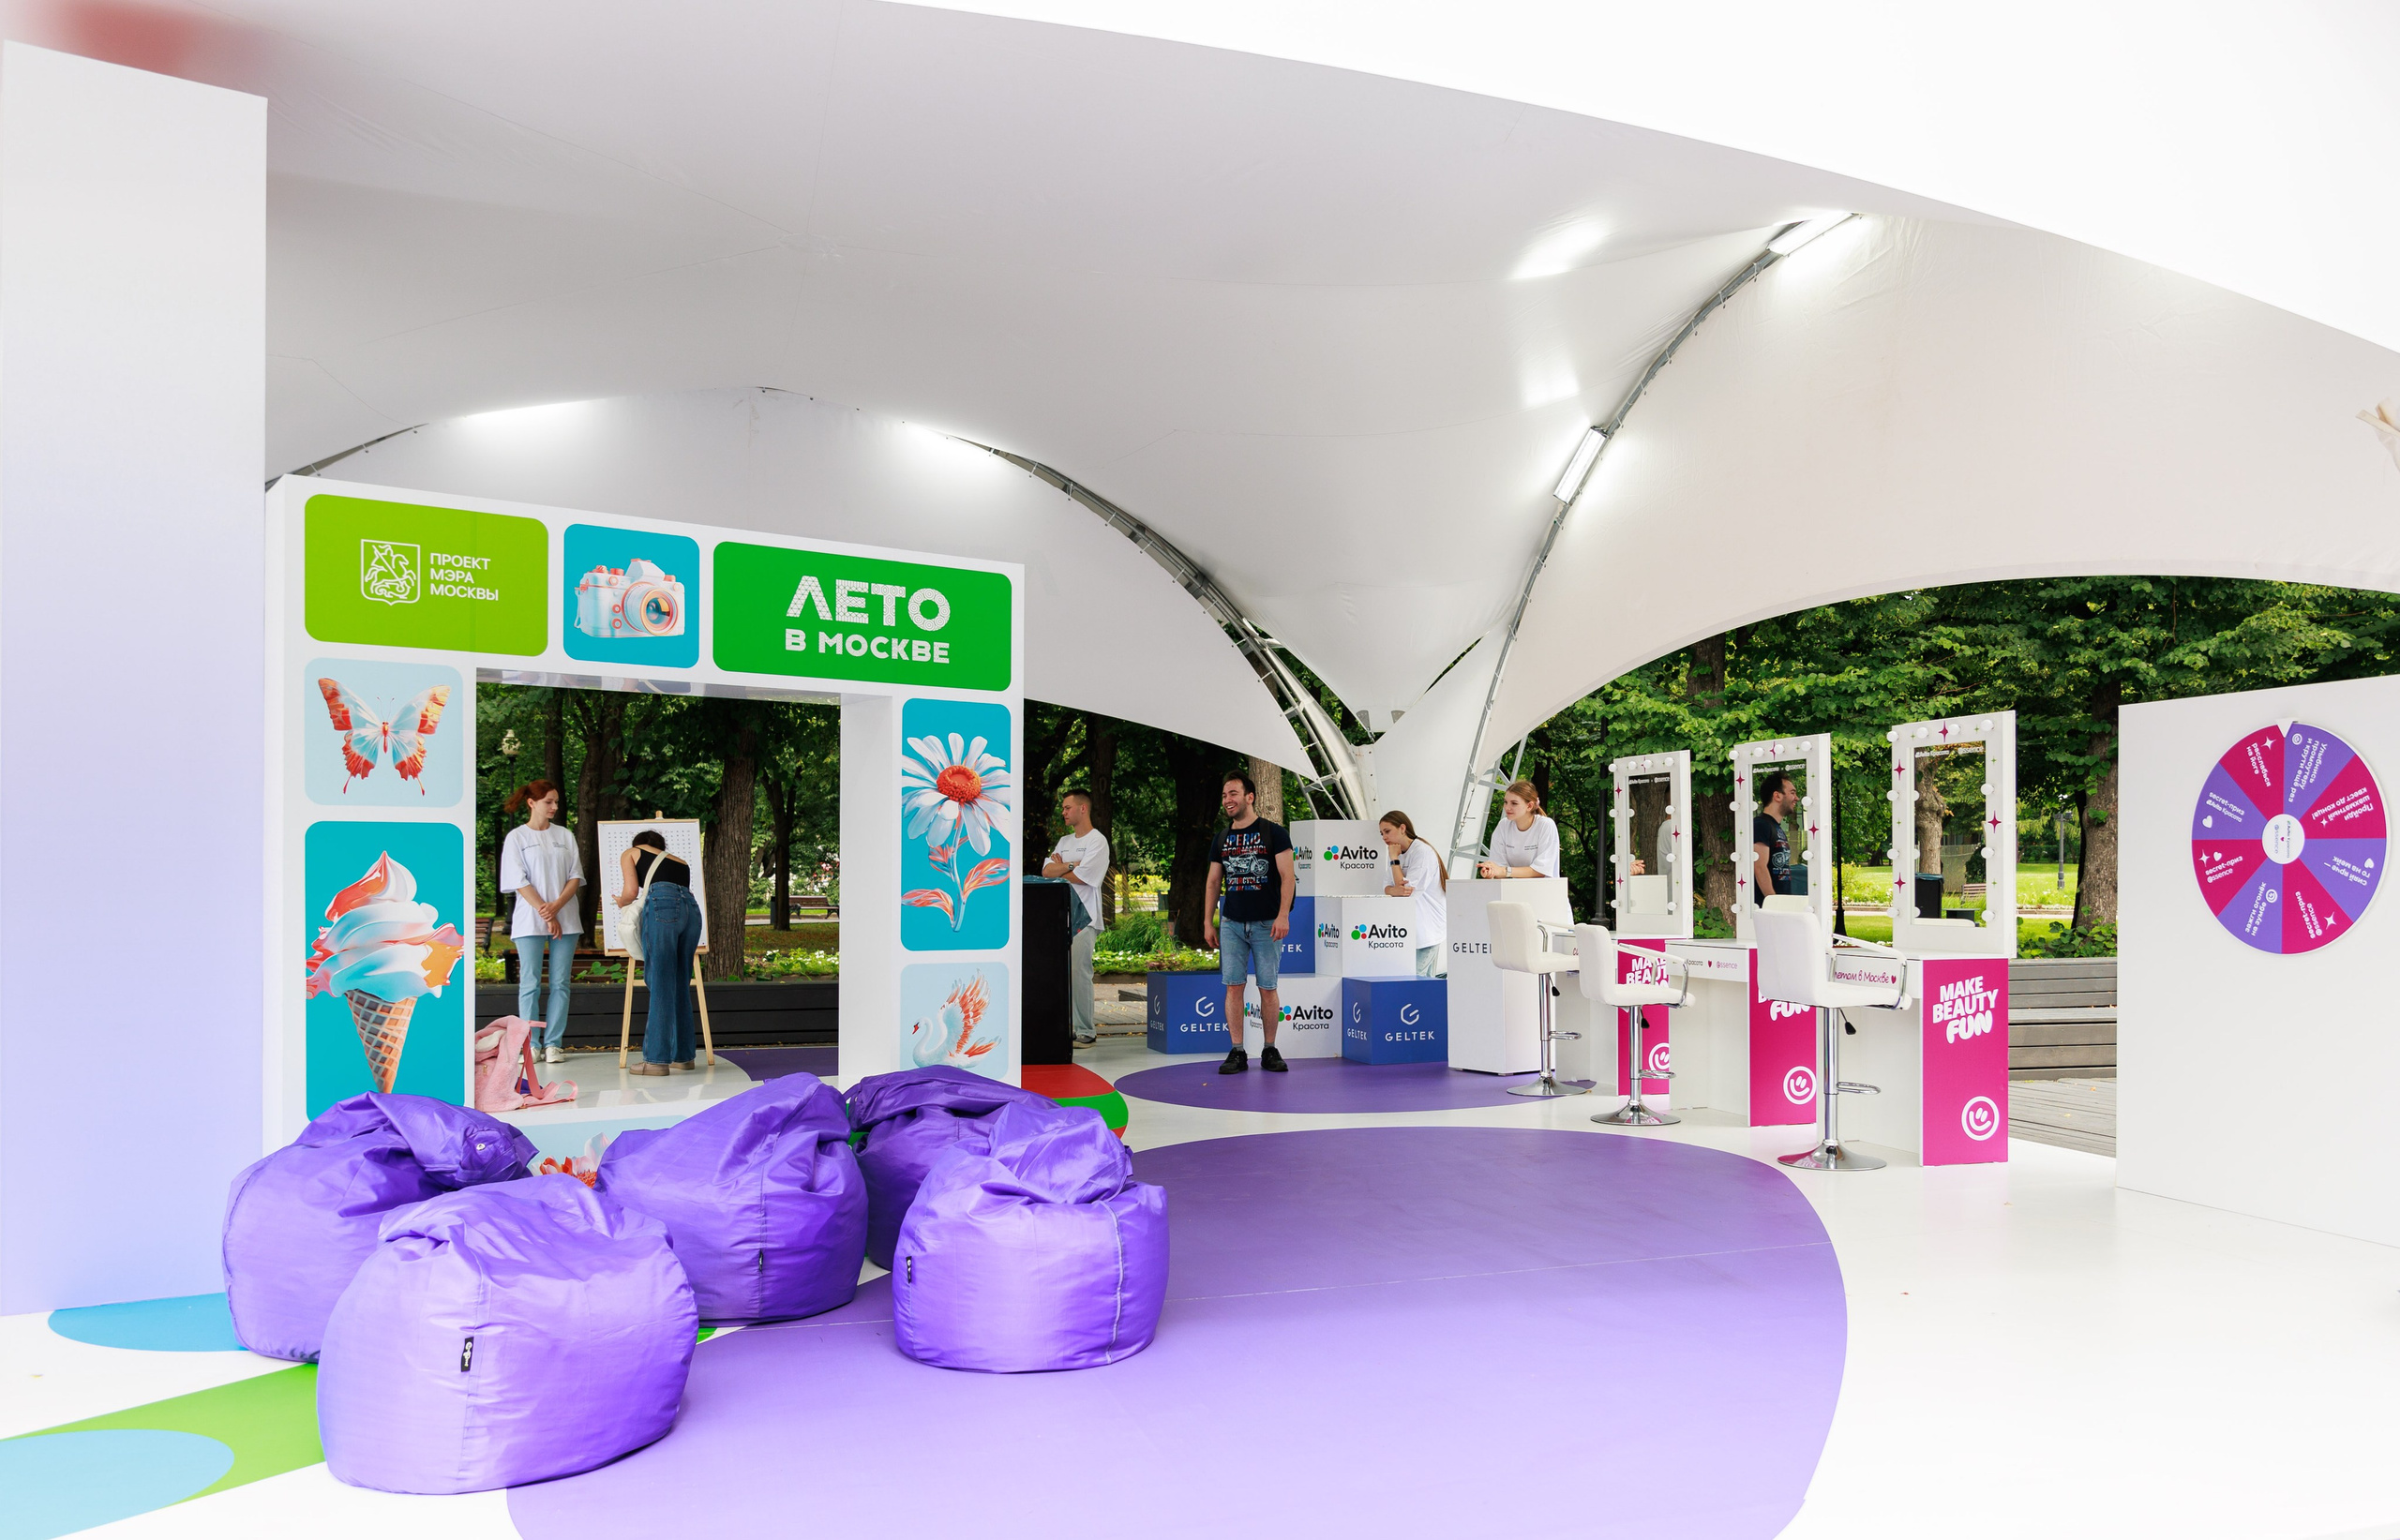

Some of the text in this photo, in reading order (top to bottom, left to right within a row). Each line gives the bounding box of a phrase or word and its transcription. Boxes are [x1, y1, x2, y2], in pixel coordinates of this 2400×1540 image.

[429, 552, 491, 571] ПРОЕКТ
[429, 568, 474, 584] МЭРА
[429, 583, 499, 601] МОСКВЫ
[786, 575, 951, 632] ЛЕТО
[785, 628, 950, 664] В МОСКВЕ
[2246, 746, 2253, 756] на
[2299, 744, 2310, 769] крути
[2251, 742, 2272, 786] расслабься
[2298, 740, 2319, 790] промоутеру
[2309, 743, 2328, 784] Улыбнись
[2293, 770, 2302, 787] ещё
[2288, 786, 2297, 802] раз
[2312, 787, 2367, 820] квест до конца!
[2328, 795, 2370, 821] шахматный
[2344, 803, 2374, 820] Пройди
[1298, 845, 1312, 860] Avito
[1340, 845, 1378, 860] Avito
[1340, 861, 1374, 870] Красота
[2331, 864, 2349, 877] ярче
[2332, 856, 2371, 878] го на мейк
[2348, 874, 2367, 886] сияй
[2244, 882, 2267, 933] зажги огонёк
[2251, 902, 2267, 936] на зумбе
[1324, 920, 1340, 939] Avito
[1368, 924, 1408, 938] Avito
[1368, 940, 1404, 949] Красота
[1864, 972, 1889, 983] Москве
[1940, 976, 1984, 1003] MAKE
[1250, 1003, 1262, 1019] Avit
[1292, 1005, 1333, 1020] Avito
[1932, 989, 1999, 1024] BEAUTY
[1149, 1020, 1164, 1031] GELTEK
[1180, 1023, 1229, 1032] GELTEK
[1293, 1023, 1329, 1031] Красота
[1347, 1028, 1368, 1040] GELTEK
[1946, 1009, 1993, 1044] FUN
[1385, 1031, 1434, 1041] GELTEK
